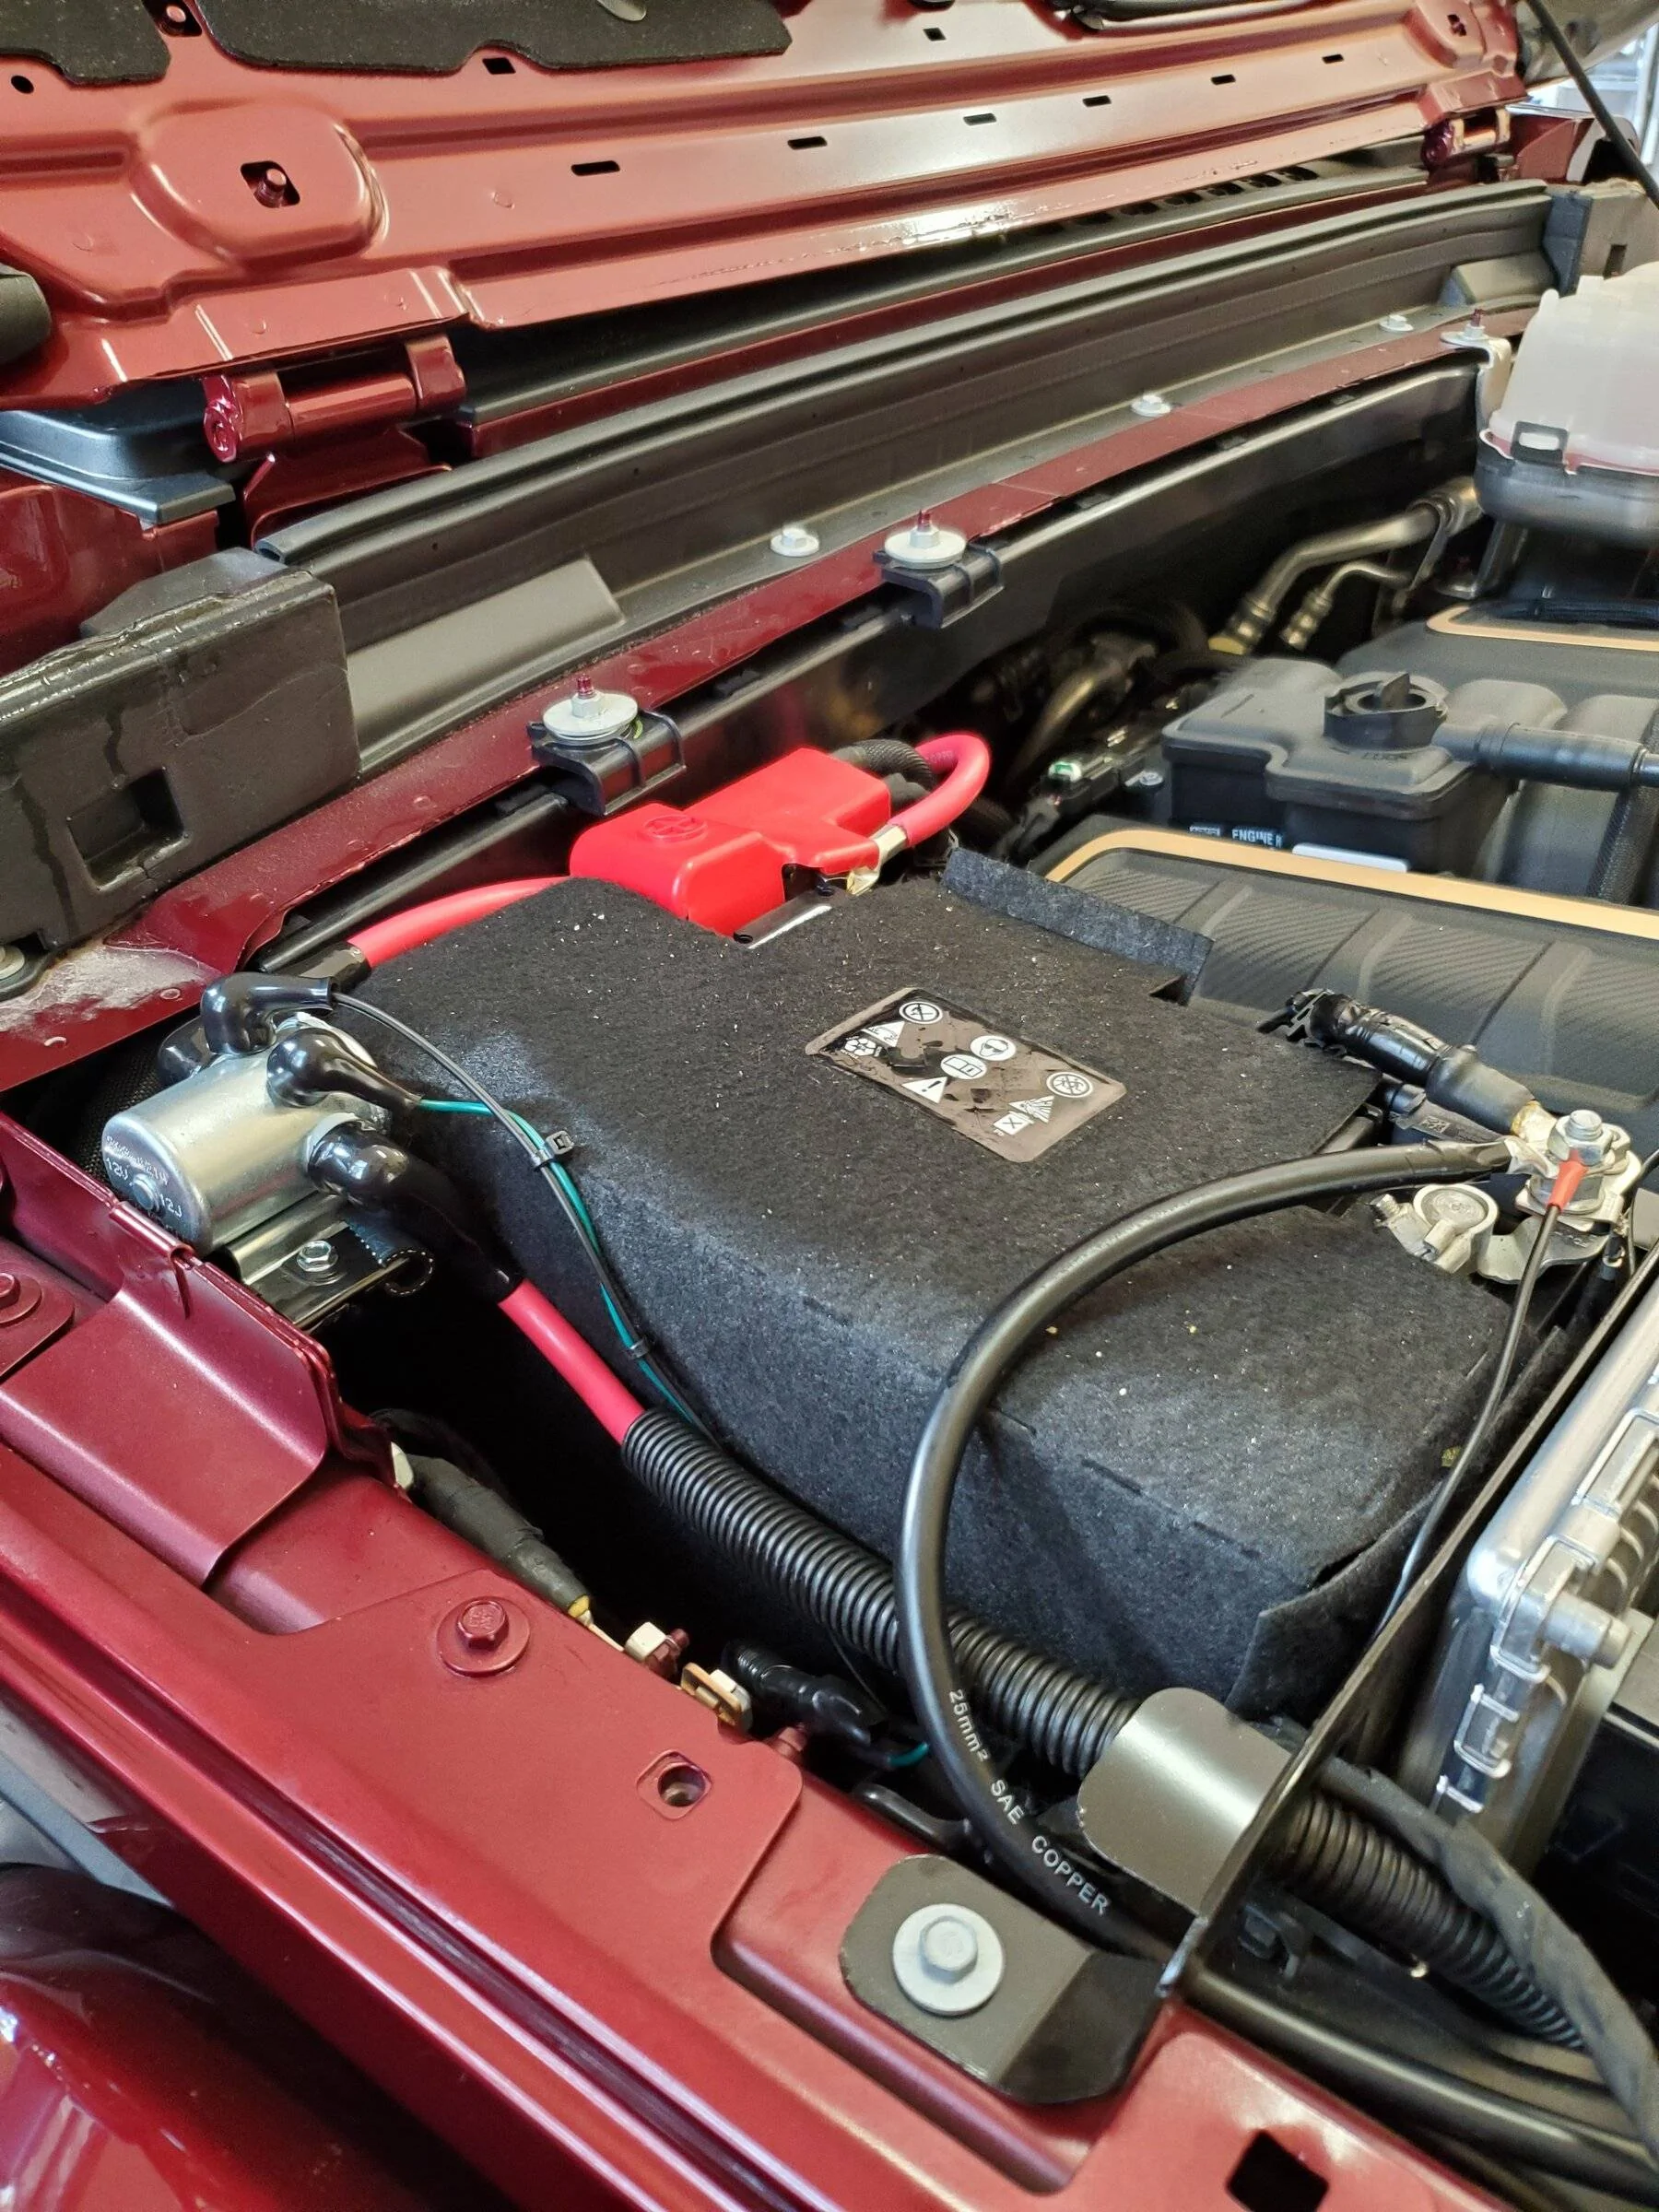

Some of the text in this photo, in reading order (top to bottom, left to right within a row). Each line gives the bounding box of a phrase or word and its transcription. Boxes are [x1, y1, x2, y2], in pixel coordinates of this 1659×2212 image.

[1231, 828, 1276, 845] ENGINE
[990, 1779, 1025, 1826] SAE
[1031, 1835, 1112, 1916] COPPER
